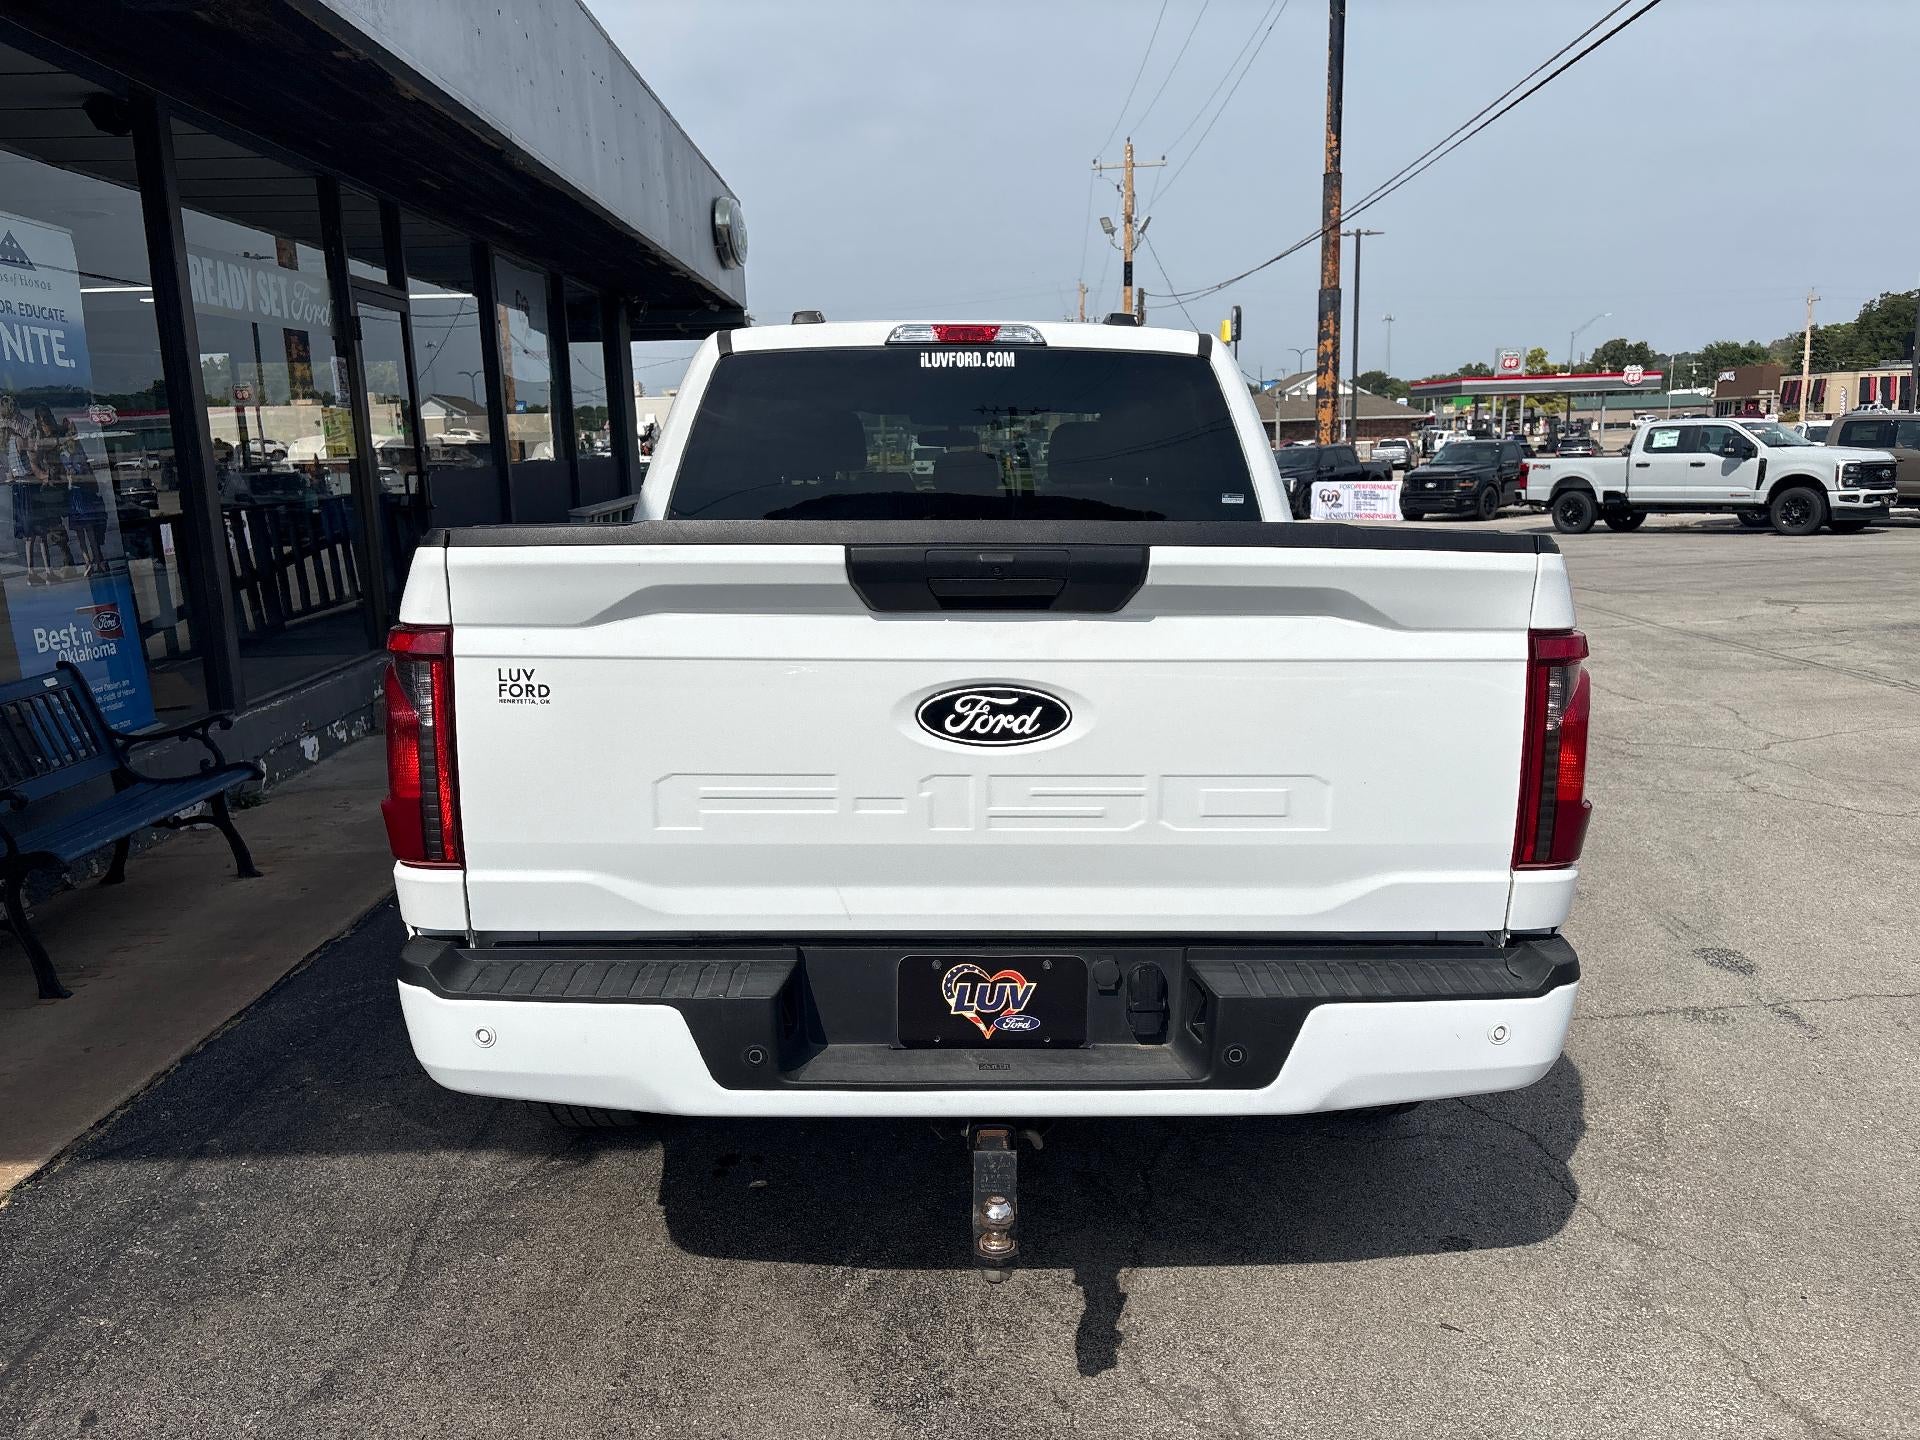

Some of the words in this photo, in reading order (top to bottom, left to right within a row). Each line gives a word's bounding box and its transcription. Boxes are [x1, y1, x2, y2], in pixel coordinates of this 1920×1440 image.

[187, 253, 254, 312] READY
[256, 270, 289, 319] SET
[291, 280, 334, 327] Ford
[18, 302, 69, 323] EDUCATE.
[920, 351, 1015, 367] iLUVFORD.COM
[33, 622, 80, 653] Best
[81, 628, 93, 644] in
[58, 641, 117, 664] Oklahoma
[498, 668, 535, 682] LUV
[498, 683, 551, 698] FORD
[943, 694, 1042, 736] Ford
[652, 773, 1331, 831] F-150
[951, 982, 1037, 1014] LUV
[1002, 1017, 1032, 1030] Ford
